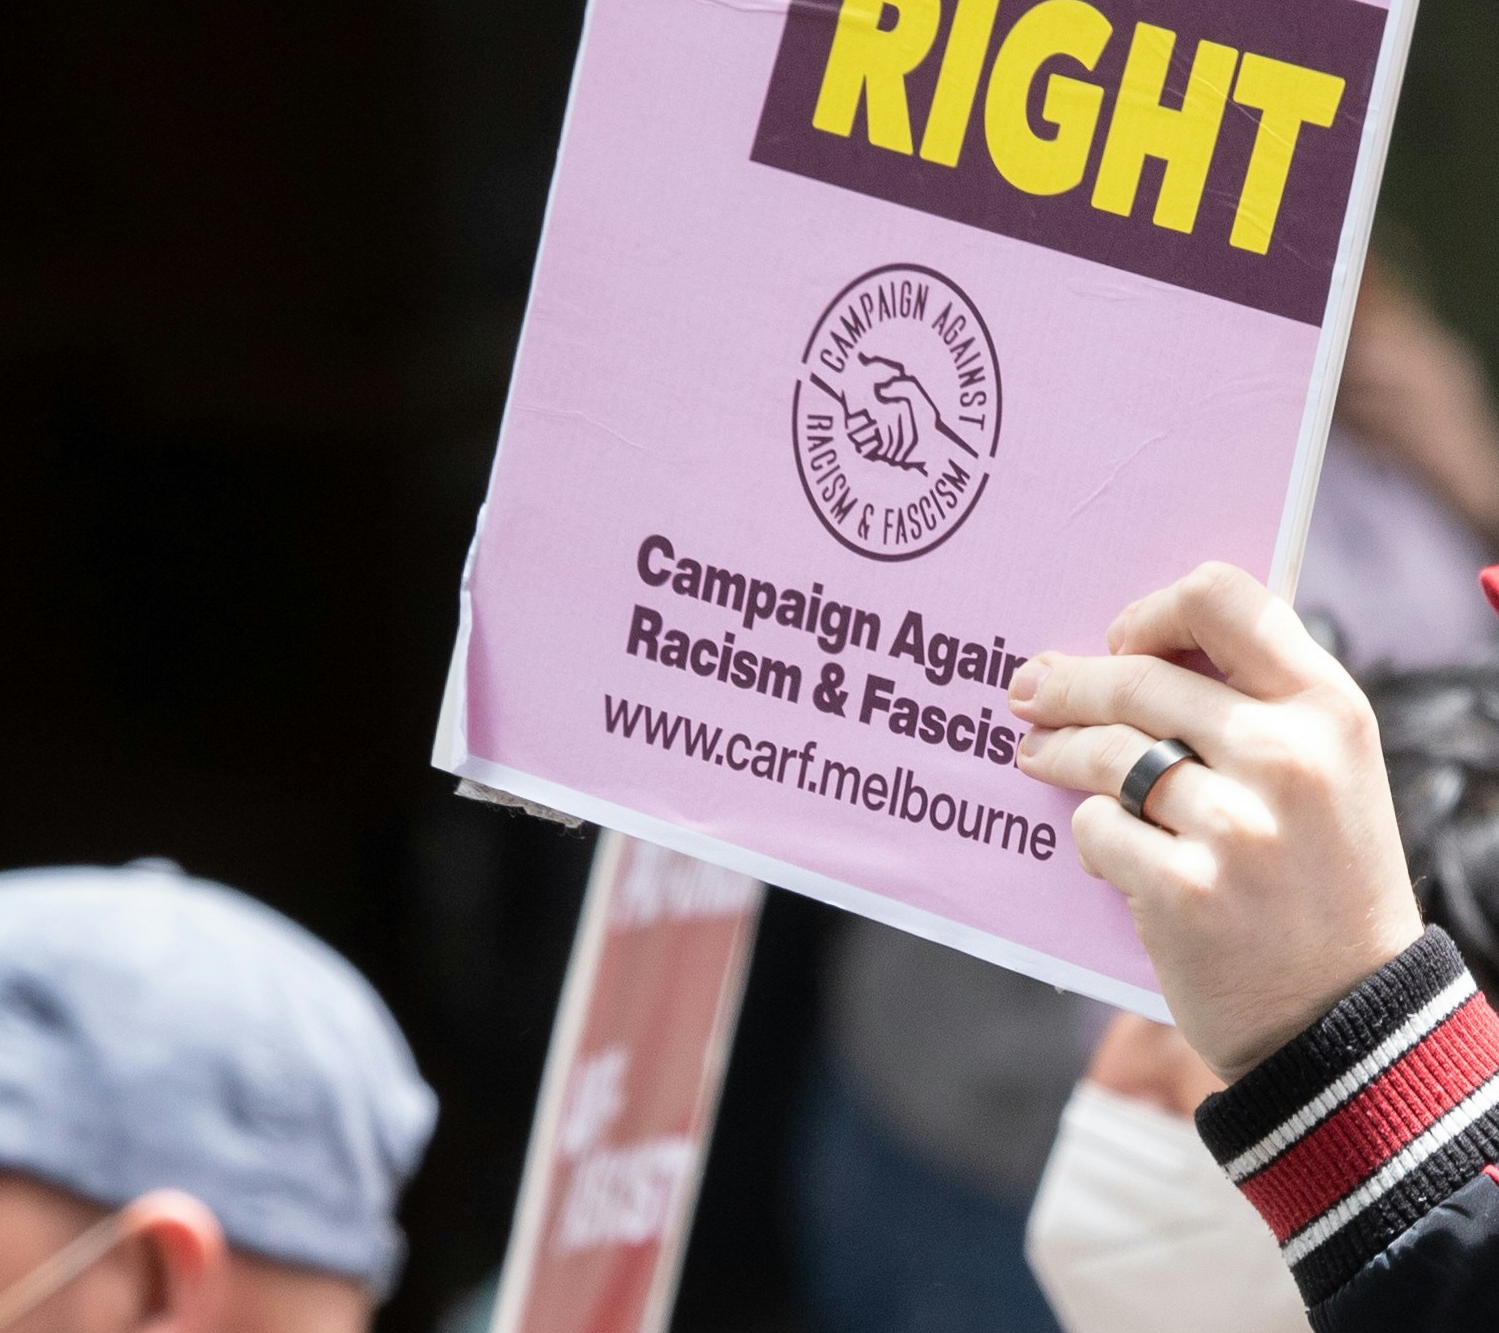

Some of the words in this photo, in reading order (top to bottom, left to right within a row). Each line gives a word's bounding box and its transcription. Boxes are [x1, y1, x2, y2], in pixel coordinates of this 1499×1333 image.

[820, 280, 929, 374] CAMPAIGN
[932, 302, 987, 431] AGAINST
[807, 414, 858, 524] RACISM
[857, 503, 874, 540] &
[883, 458, 970, 545] FASCISM
[637, 534, 881, 654] Campaign
[626, 604, 802, 703] Racism
[813, 662, 850, 718] &
[859, 674, 1024, 769] Fascis
[604, 694, 1056, 862] www.carf.melbourne
